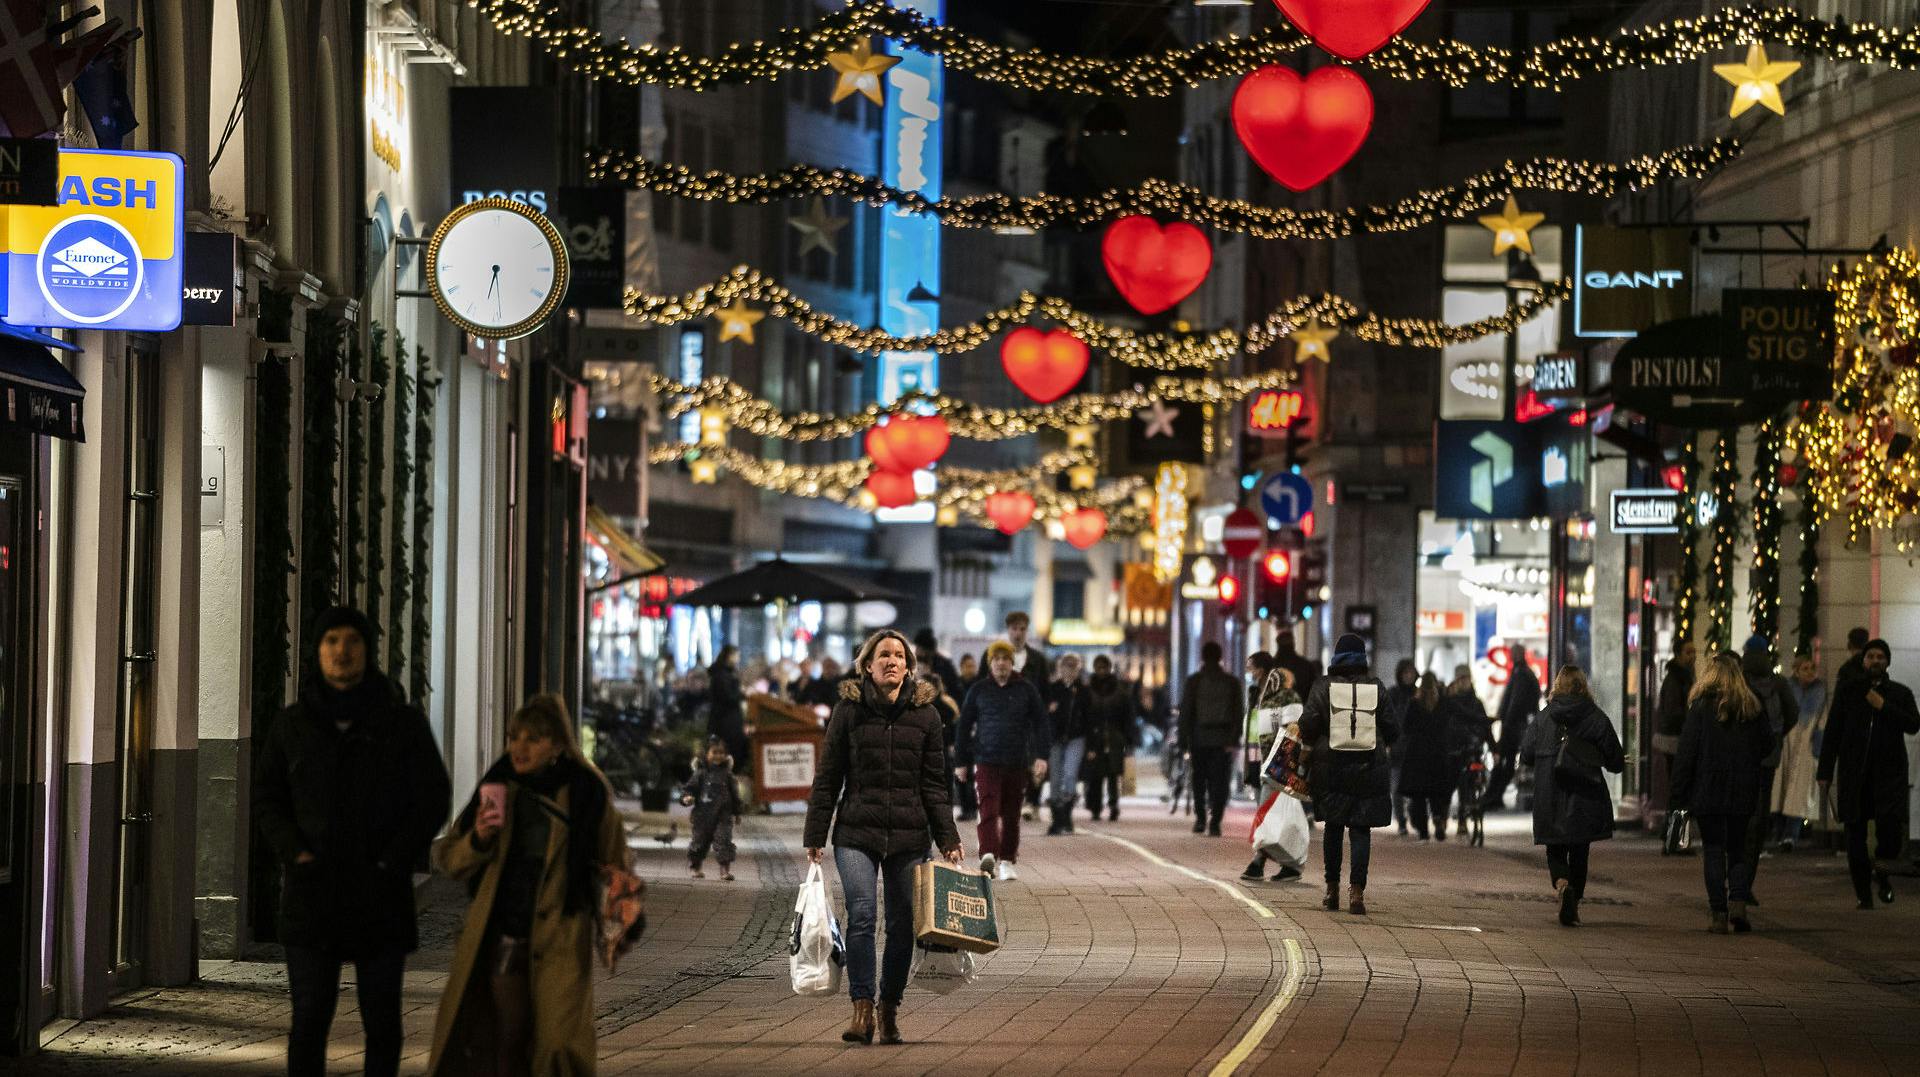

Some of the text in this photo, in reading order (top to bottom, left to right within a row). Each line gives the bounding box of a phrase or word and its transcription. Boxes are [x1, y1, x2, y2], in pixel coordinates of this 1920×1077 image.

[58, 175, 157, 209] ASH
[65, 249, 116, 264] Euronet
[52, 278, 129, 288] WORLDWIDE
[1584, 269, 1684, 289] GANT
[1741, 305, 1815, 332] POUL
[1746, 335, 1808, 361] STIG
[1631, 358, 1721, 387] PISTOLST
[950, 898, 985, 918] TOGETHER
